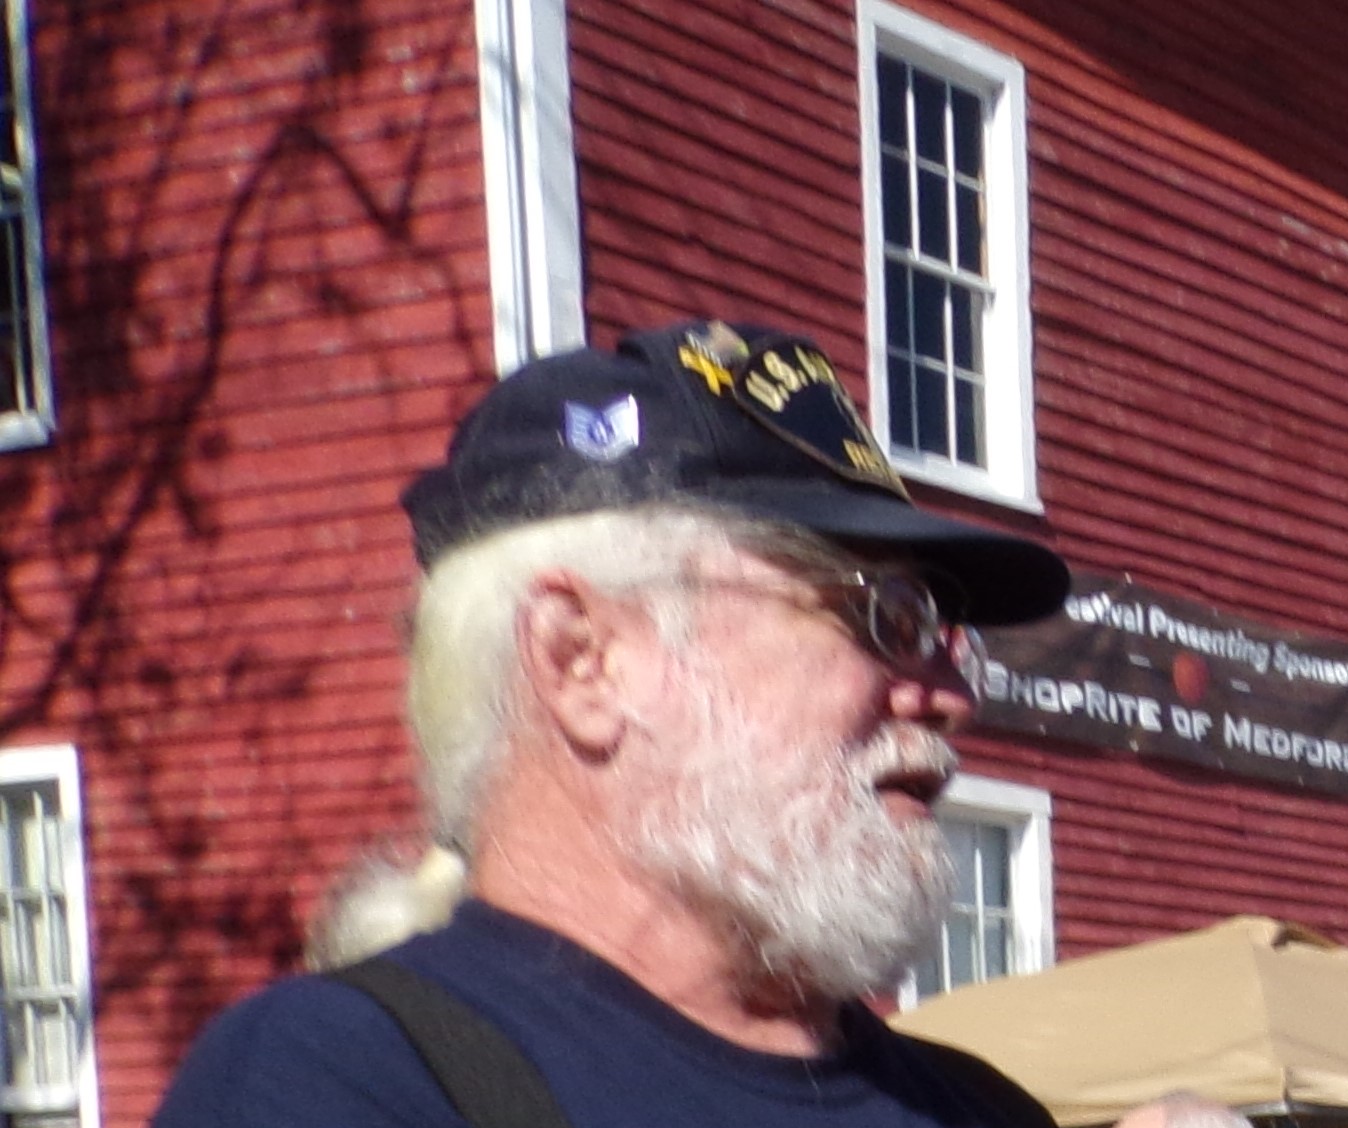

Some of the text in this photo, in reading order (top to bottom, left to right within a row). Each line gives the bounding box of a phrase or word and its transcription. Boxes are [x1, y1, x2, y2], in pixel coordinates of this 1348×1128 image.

[1064, 591, 1145, 636] estival
[1148, 604, 1270, 675] Presenting
[1171, 704, 1214, 741] OF
